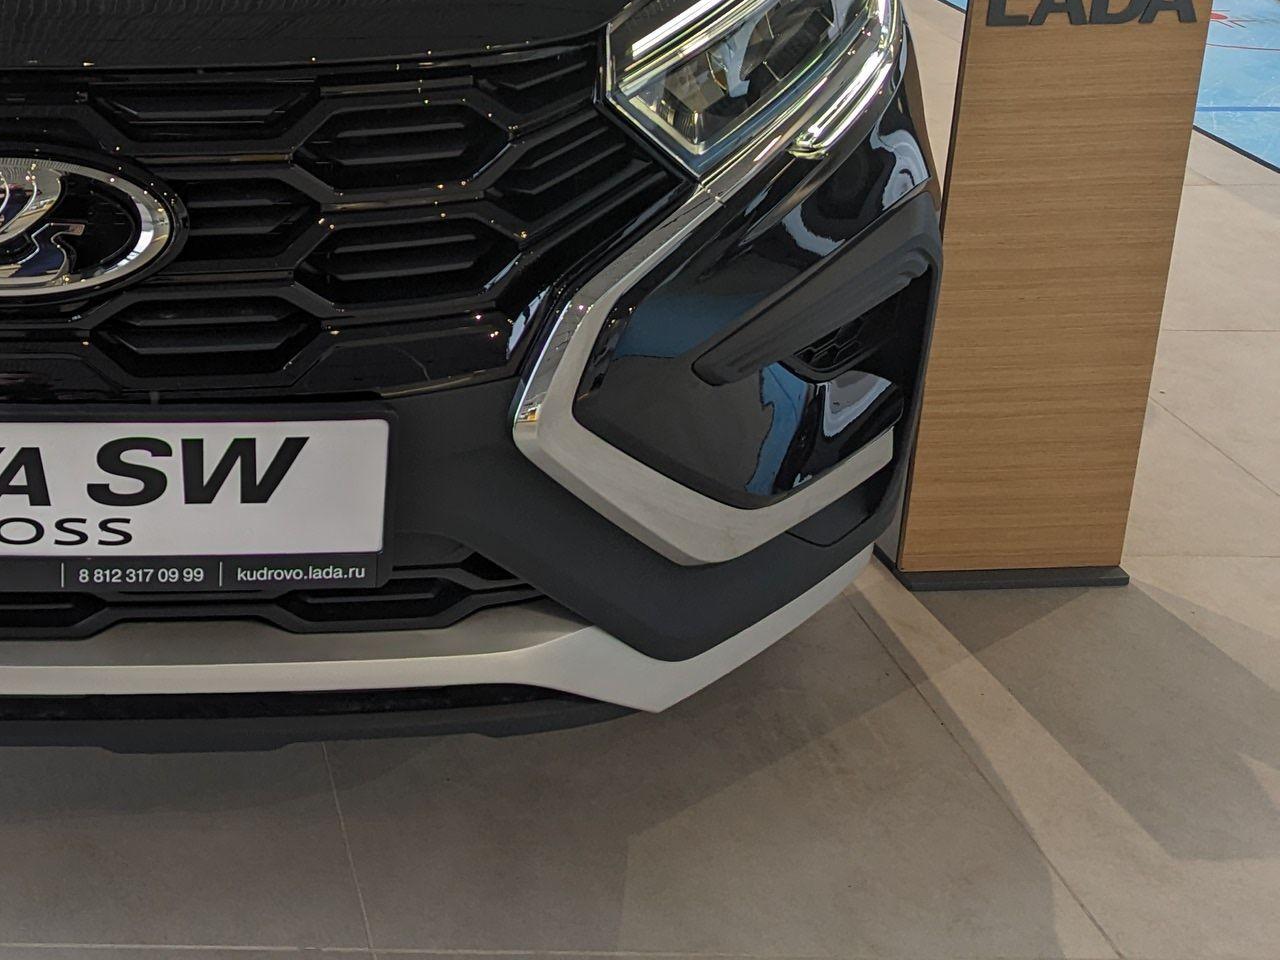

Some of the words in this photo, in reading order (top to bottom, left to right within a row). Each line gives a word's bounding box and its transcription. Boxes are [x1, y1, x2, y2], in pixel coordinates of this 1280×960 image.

[86, 436, 310, 507] SW
[78, 569, 90, 583] 8
[93, 568, 122, 583] 812
[125, 568, 154, 582] 317
[157, 568, 180, 582] 09
[182, 567, 204, 582] 99
[236, 565, 366, 581] kudrovo.lada.ru
